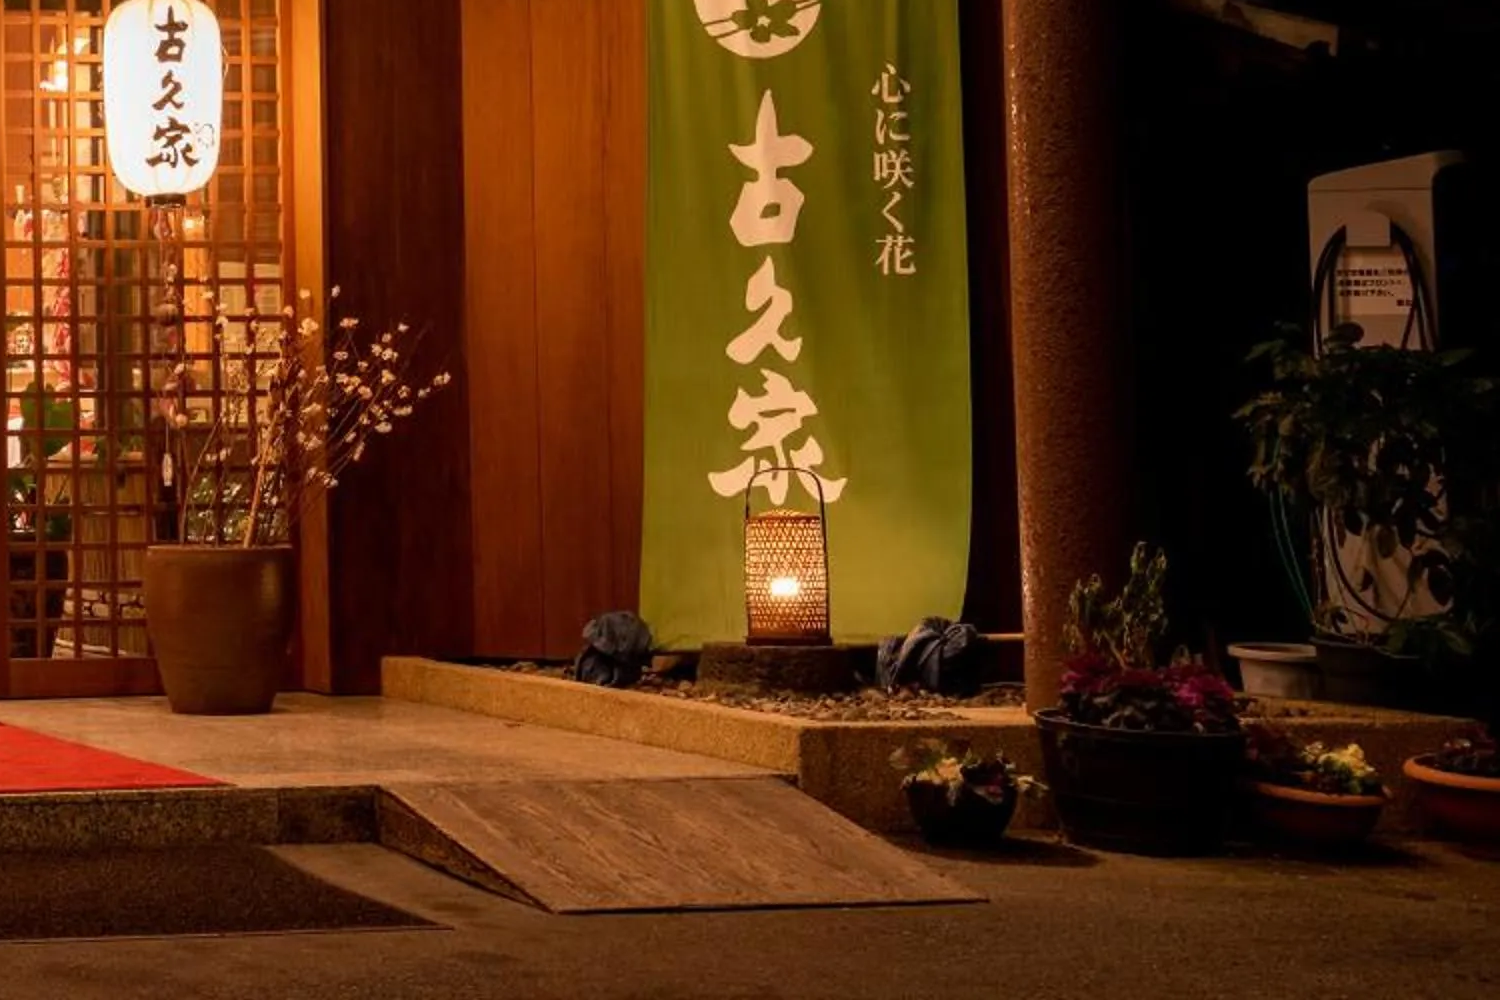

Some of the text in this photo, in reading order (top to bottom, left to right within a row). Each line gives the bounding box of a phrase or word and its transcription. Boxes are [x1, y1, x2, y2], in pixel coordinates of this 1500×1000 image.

[145, 5, 199, 169] 古久家
[871, 63, 918, 277] 心に咲く花
[708, 88, 848, 506] 古久家
